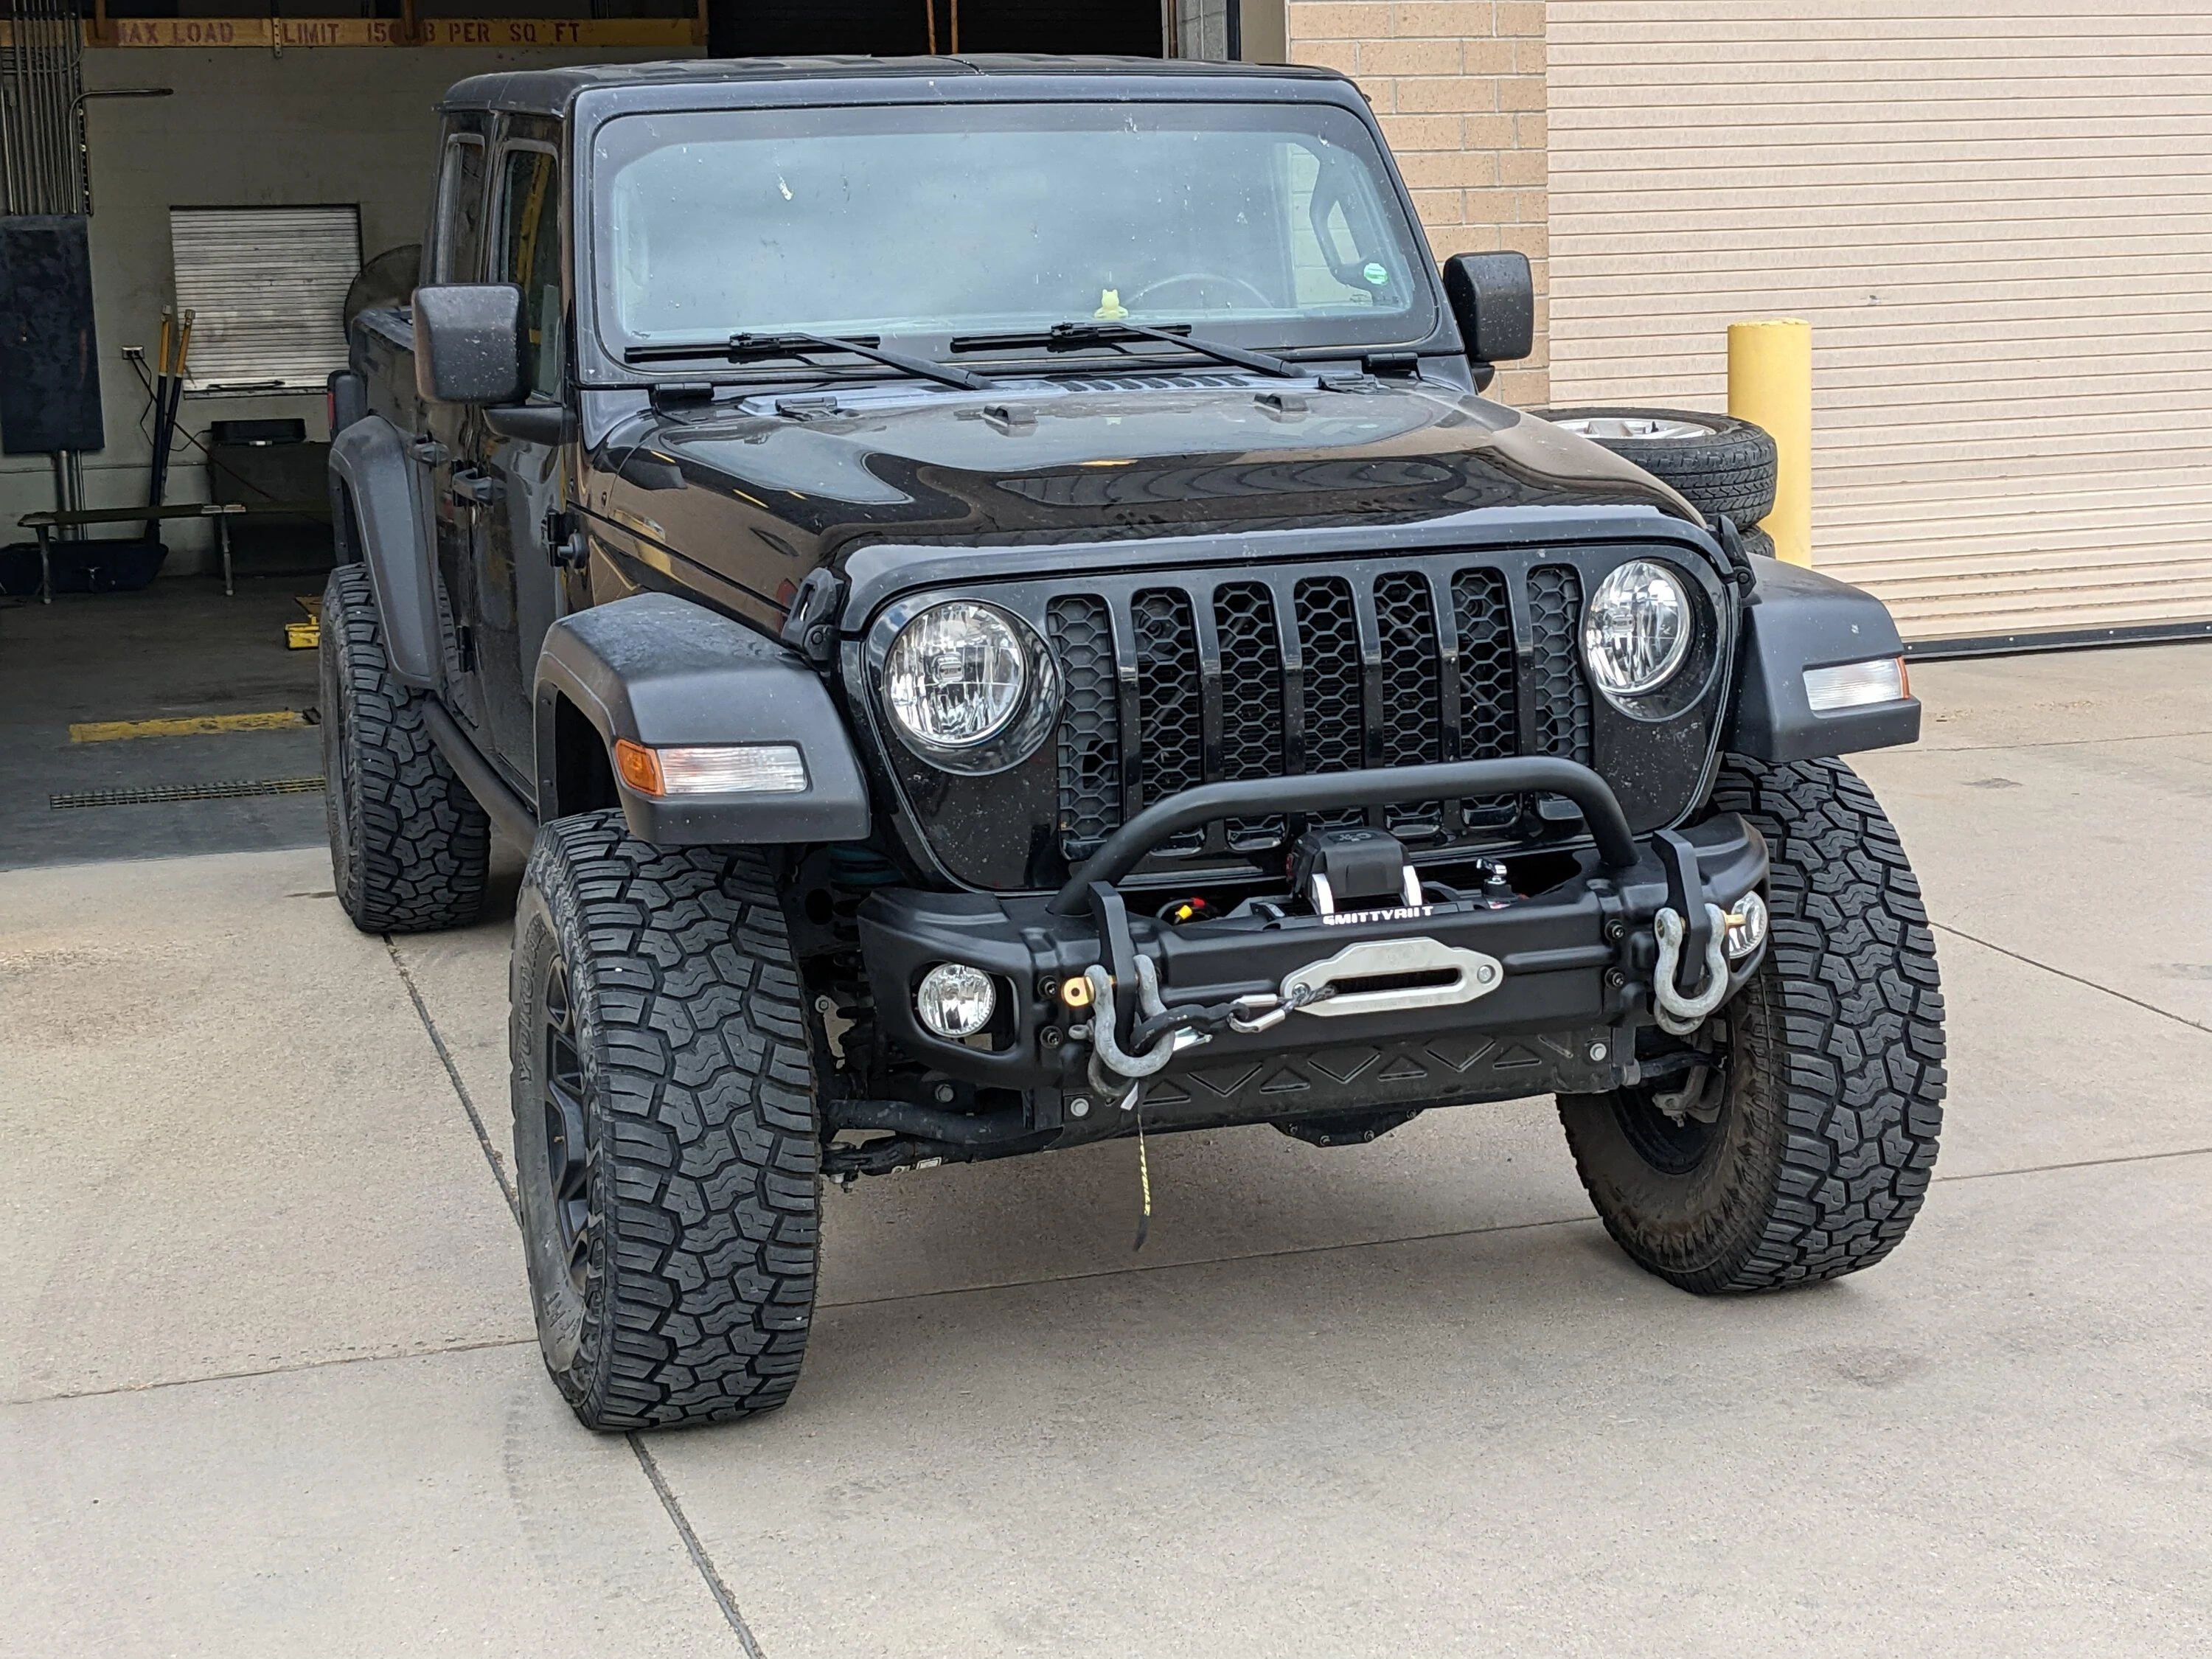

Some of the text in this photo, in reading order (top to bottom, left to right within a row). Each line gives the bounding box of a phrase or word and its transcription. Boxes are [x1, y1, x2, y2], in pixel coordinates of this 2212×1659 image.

[171, 22, 234, 44] LOAD
[282, 23, 339, 43] LIMIT
[449, 22, 490, 43] PER
[509, 23, 537, 42] SQ
[554, 23, 580, 42] FT
